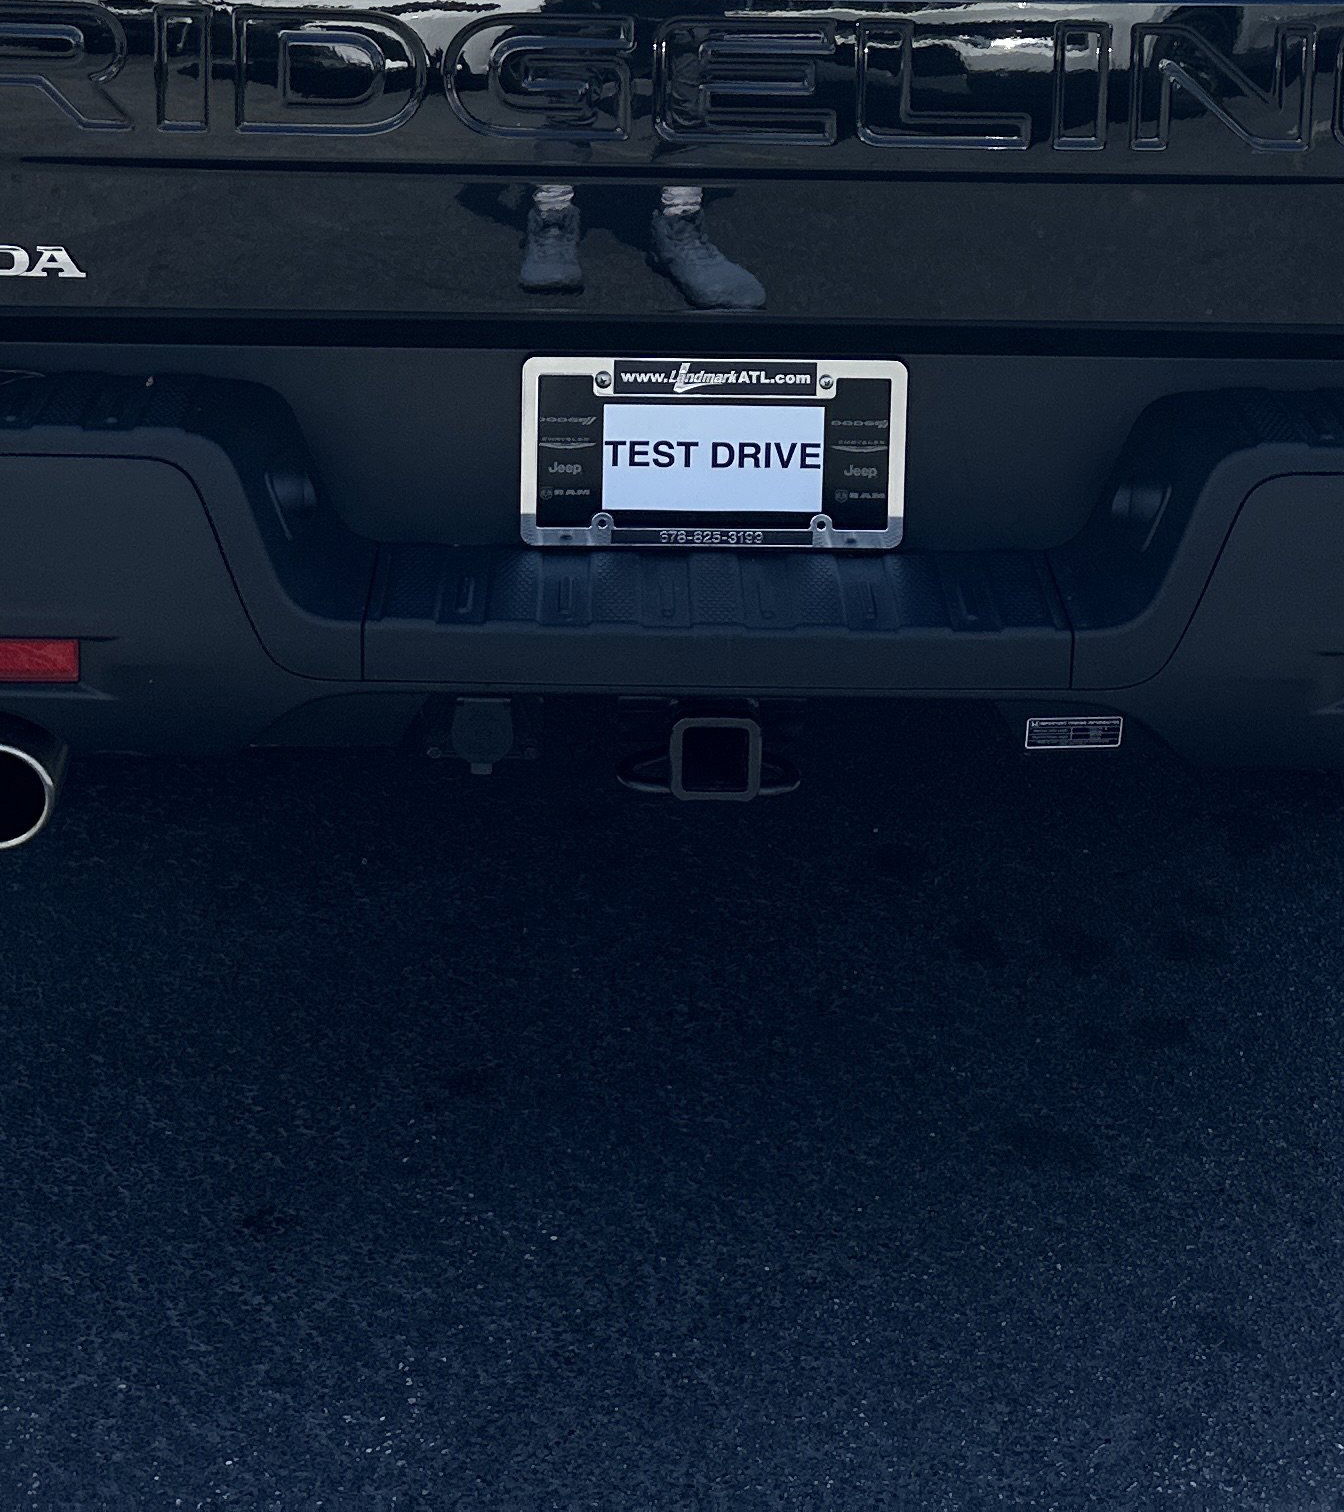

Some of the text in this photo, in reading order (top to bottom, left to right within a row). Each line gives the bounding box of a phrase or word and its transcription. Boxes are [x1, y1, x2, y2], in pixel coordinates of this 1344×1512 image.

[604, 440, 822, 470] TEST DRIVE
[548, 461, 582, 475] Jeep
[843, 464, 878, 479] Jeep
[659, 530, 763, 544] 678-825-3199
